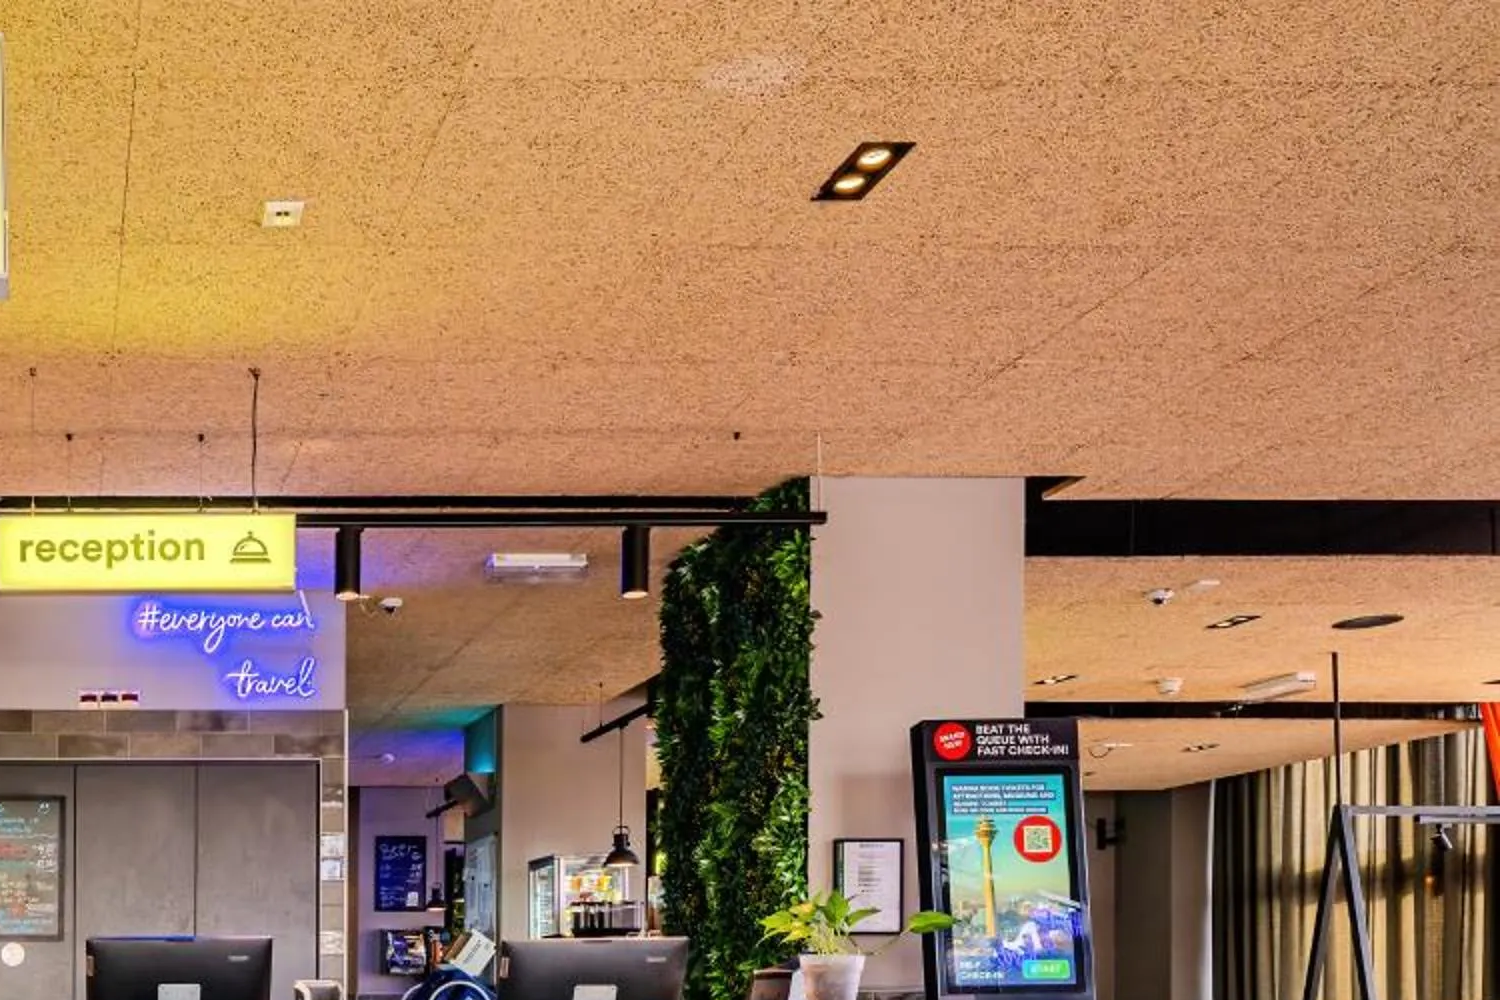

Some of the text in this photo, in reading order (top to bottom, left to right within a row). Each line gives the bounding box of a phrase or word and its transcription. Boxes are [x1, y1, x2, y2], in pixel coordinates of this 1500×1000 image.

[19, 529, 205, 569] reception
[139, 602, 315, 653] #everyone can
[226, 656, 315, 698] travel
[975, 723, 1030, 735] BEAT THE
[976, 735, 1016, 745] QUEUE
[1017, 733, 1050, 745] WITH
[977, 743, 1069, 757] FAST CHECK-IN!
